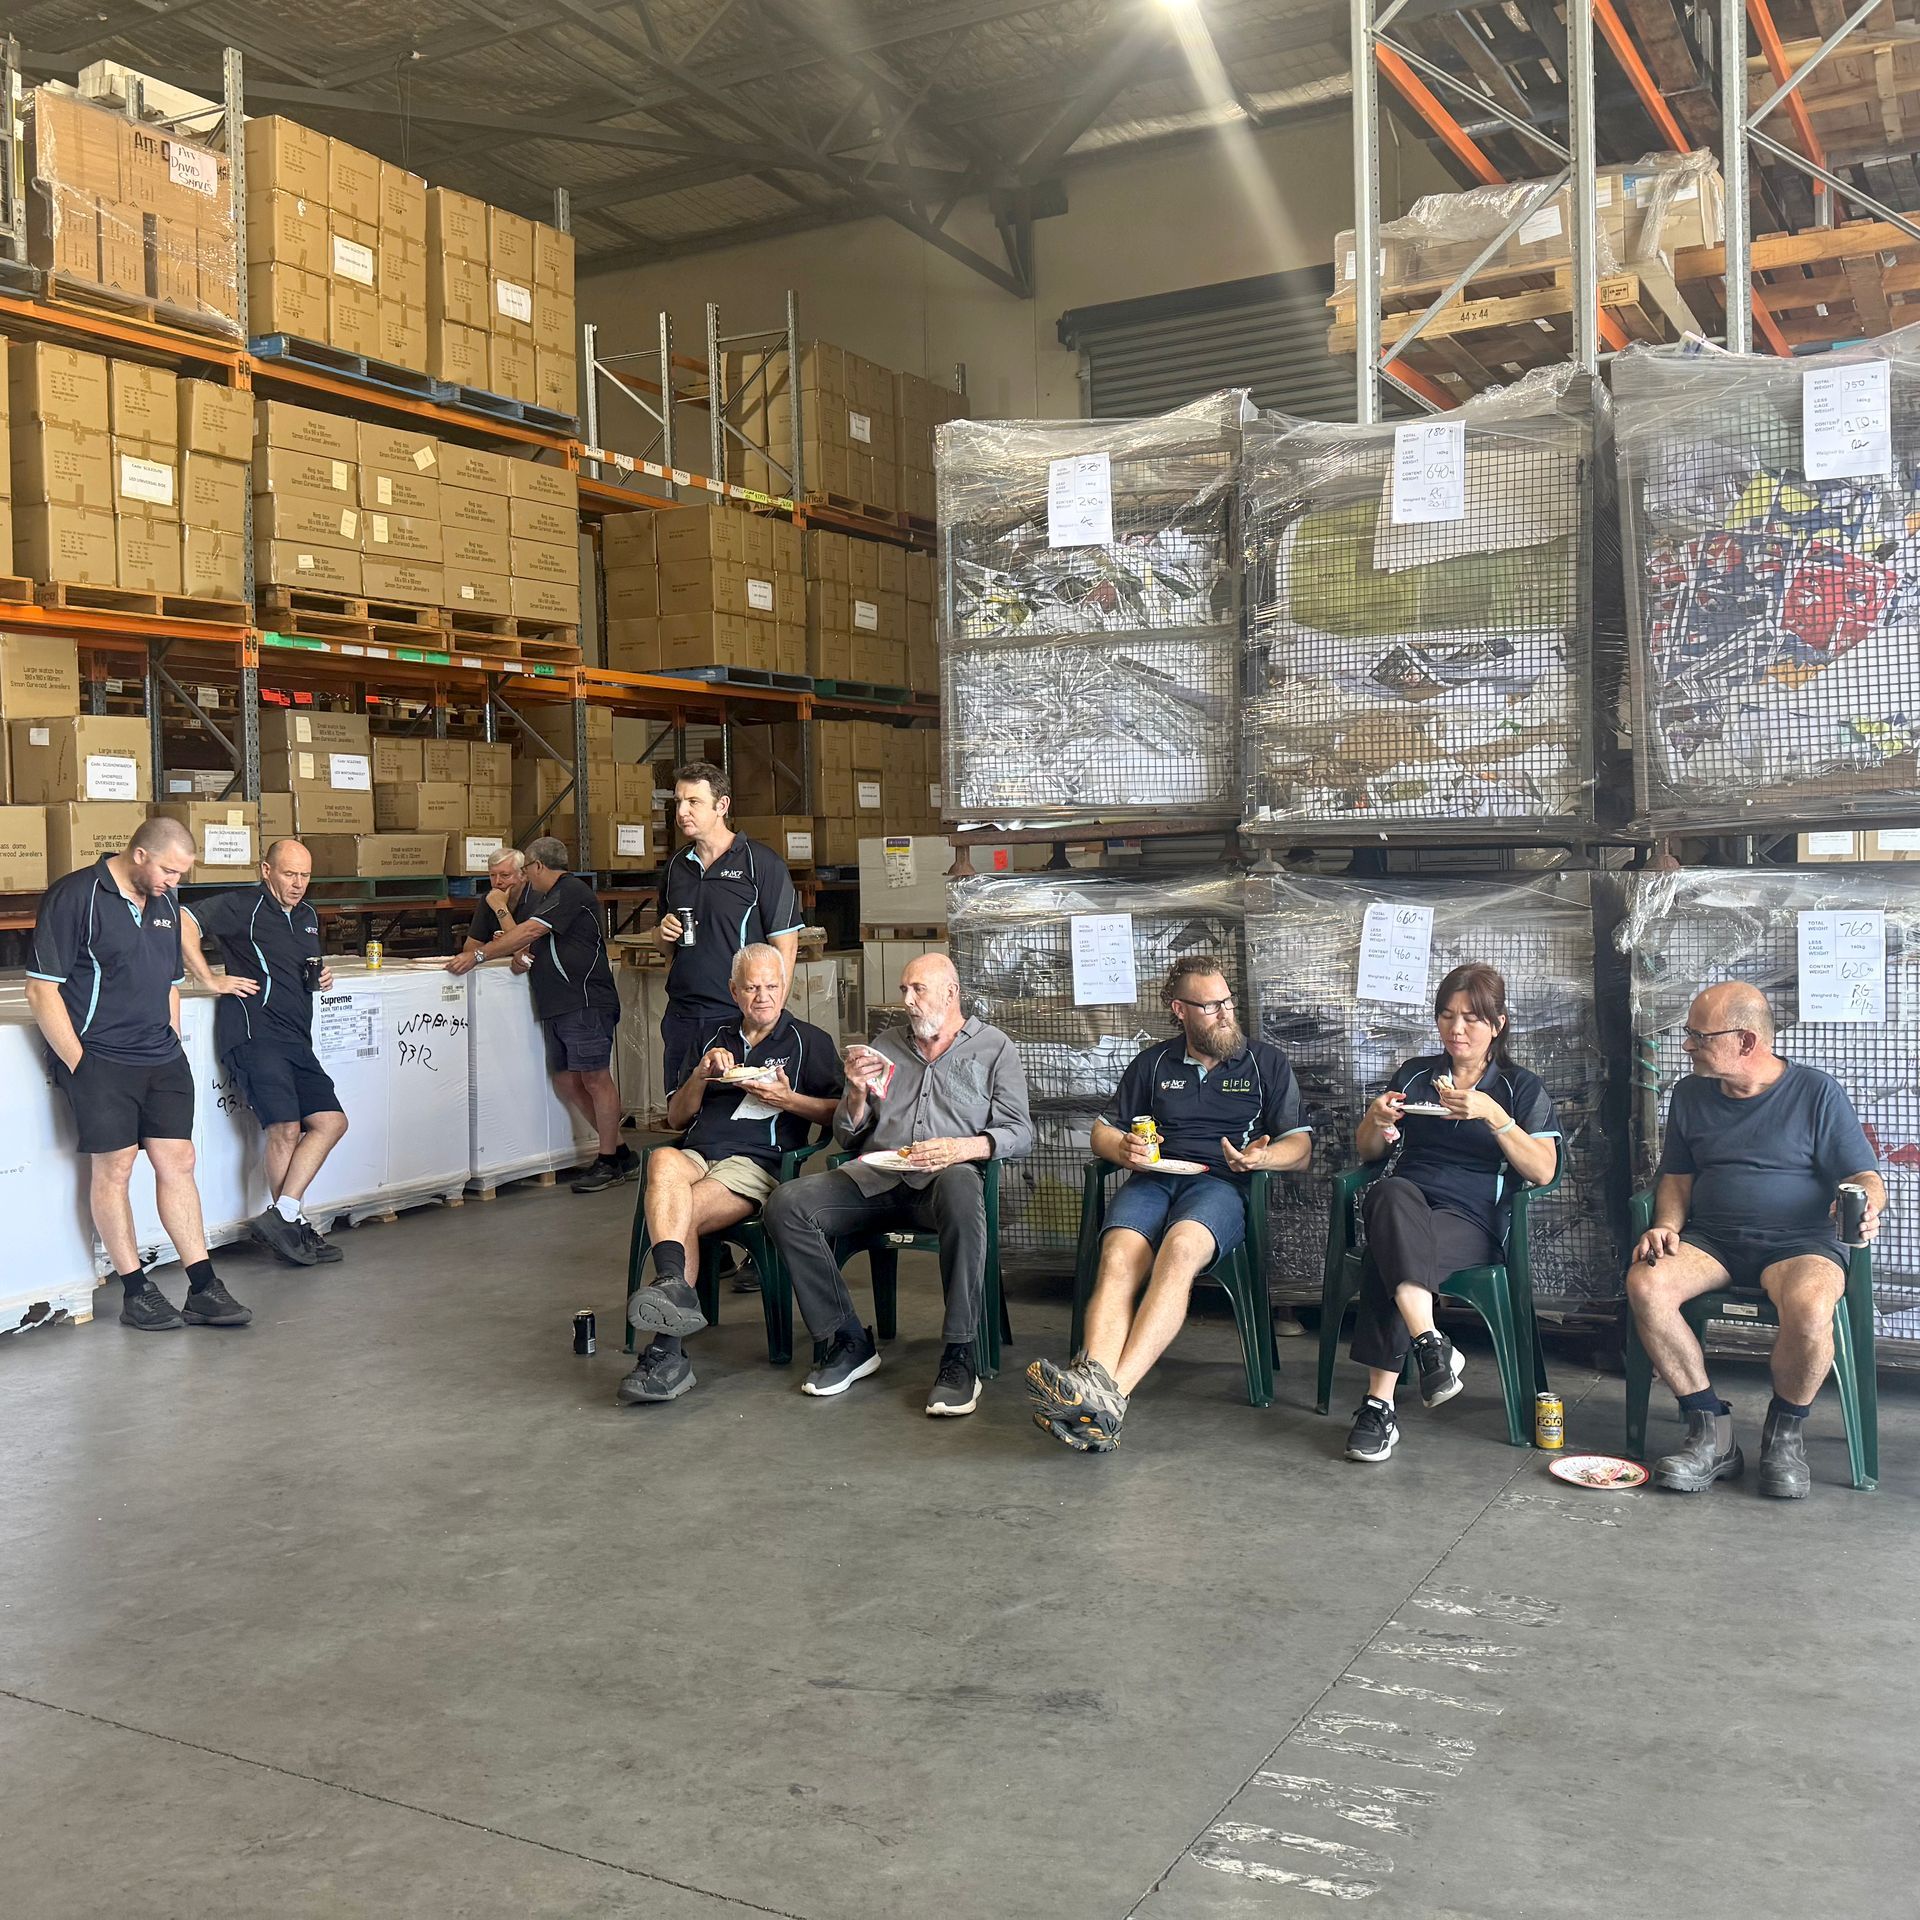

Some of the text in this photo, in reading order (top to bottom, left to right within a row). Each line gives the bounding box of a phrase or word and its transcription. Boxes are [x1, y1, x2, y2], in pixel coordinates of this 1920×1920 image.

[171, 156, 200, 176] DAVID
[1460, 312, 1471, 322] 44
[1478, 309, 1489, 319] 44
[1840, 920, 1872, 937] 760
[1842, 962, 1871, 979] 620
[321, 995, 352, 1006] Supreme
[398, 1041, 437, 1071] 9312
[1537, 1417, 1562, 1427] SOLO
